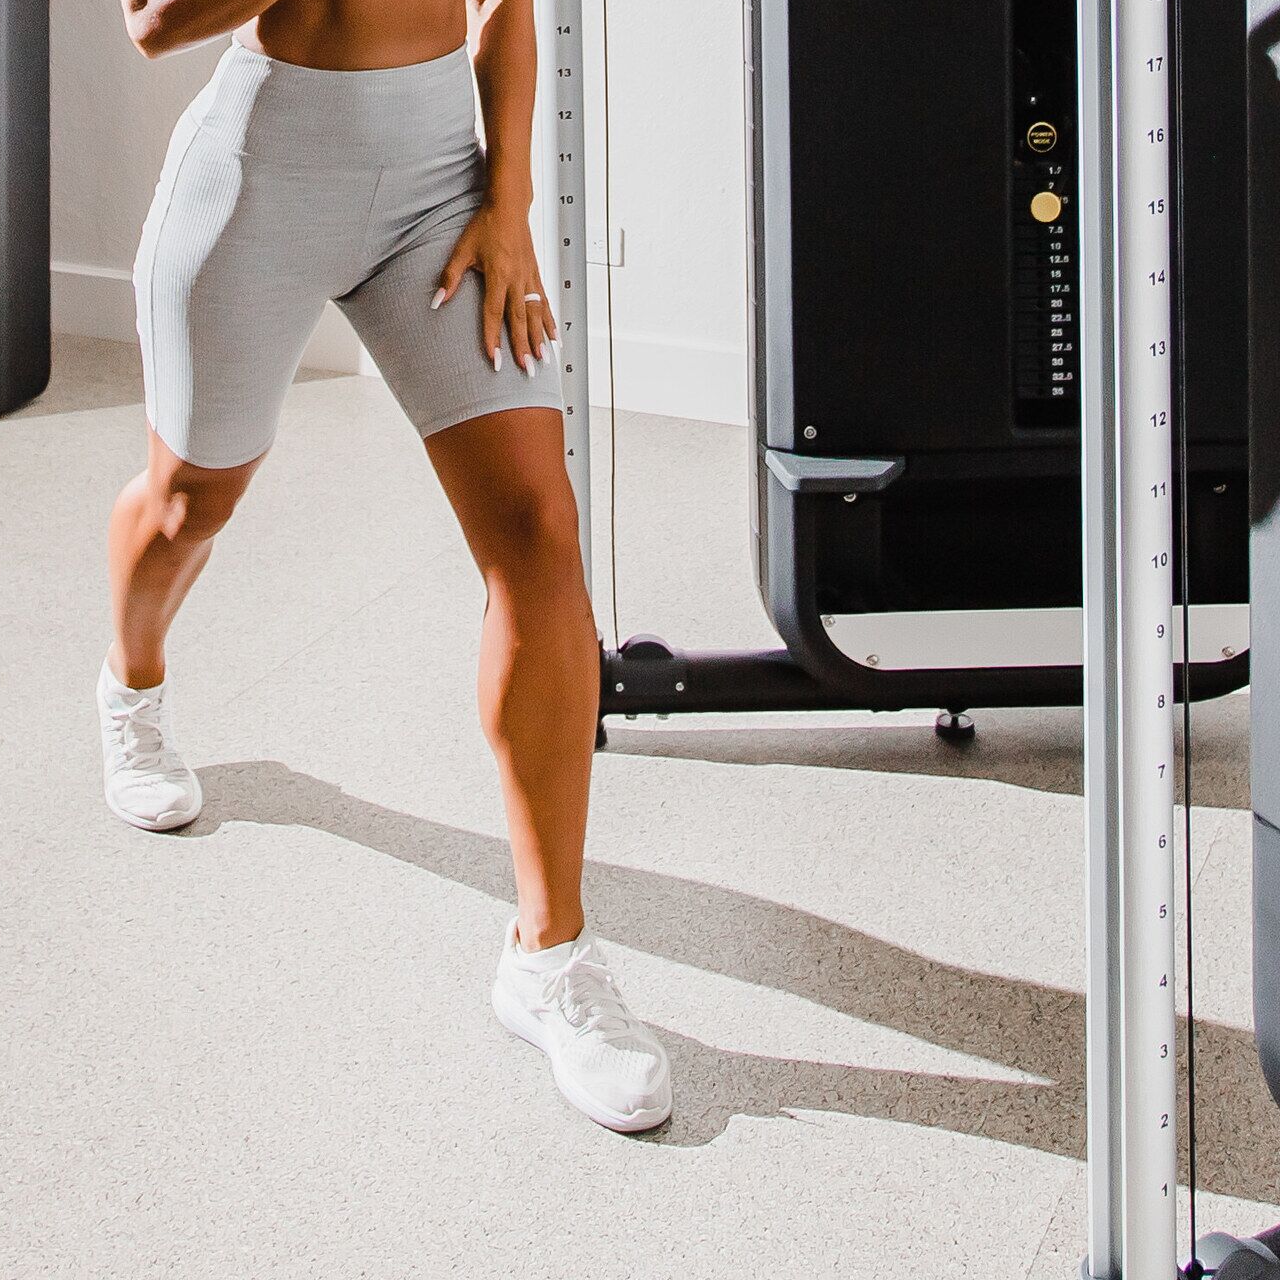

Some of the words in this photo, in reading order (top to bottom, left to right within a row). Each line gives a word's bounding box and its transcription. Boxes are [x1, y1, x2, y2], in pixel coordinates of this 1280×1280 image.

[556, 25, 571, 35] 14
[1146, 56, 1163, 72] 17
[557, 68, 572, 78] 13
[558, 110, 573, 120] 12
[1147, 128, 1164, 144] 16
[559, 152, 572, 162] 11
[559, 195, 574, 205] 10
[1148, 198, 1165, 215] 15
[563, 237, 571, 247] 9
[564, 280, 571, 289] 8
[1148, 269, 1166, 286] 14
[564, 321, 572, 331] 7
[1149, 340, 1166, 357] 13
[565, 364, 573, 373] 6
[566, 406, 574, 416] 5
[1150, 411, 1167, 428] 12
[567, 448, 575, 457] 4
[1150, 481, 1166, 498] 11
[1151, 552, 1168, 569] 10
[1156, 624, 1165, 639] 9
[1157, 694, 1165, 709] 8
[1157, 764, 1166, 779] 7
[1158, 834, 1167, 849] 6
[1159, 904, 1167, 919] 5
[1159, 974, 1168, 987] 4
[1160, 1044, 1168, 1059] 3
[1160, 1113, 1169, 1129] 2
[1161, 1183, 1168, 1197] 1
